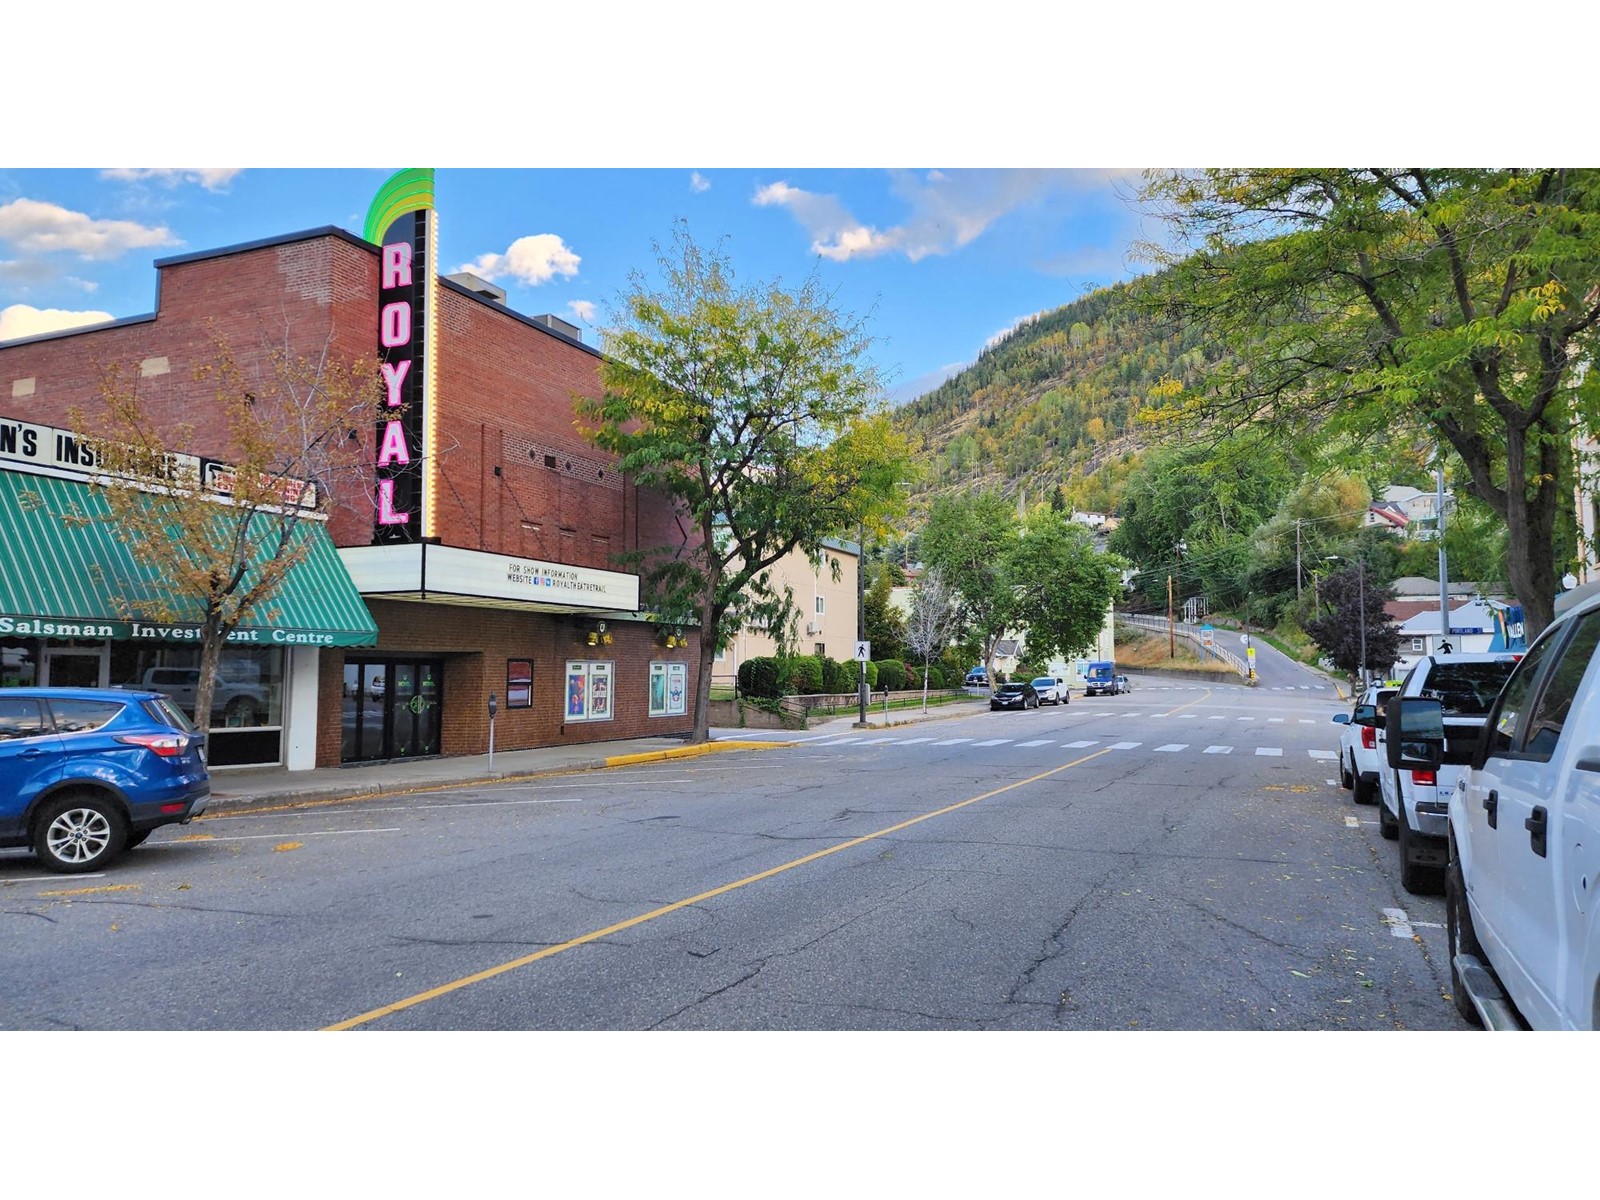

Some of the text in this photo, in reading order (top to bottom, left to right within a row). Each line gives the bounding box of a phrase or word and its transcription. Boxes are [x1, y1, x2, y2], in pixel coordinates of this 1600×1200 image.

[378, 241, 413, 525] ROYAL
[507, 573, 532, 584] WEBSITE
[509, 564, 578, 580] FOR SHOW INFORMATION
[0, 617, 334, 644] Salsman Investent Centre
